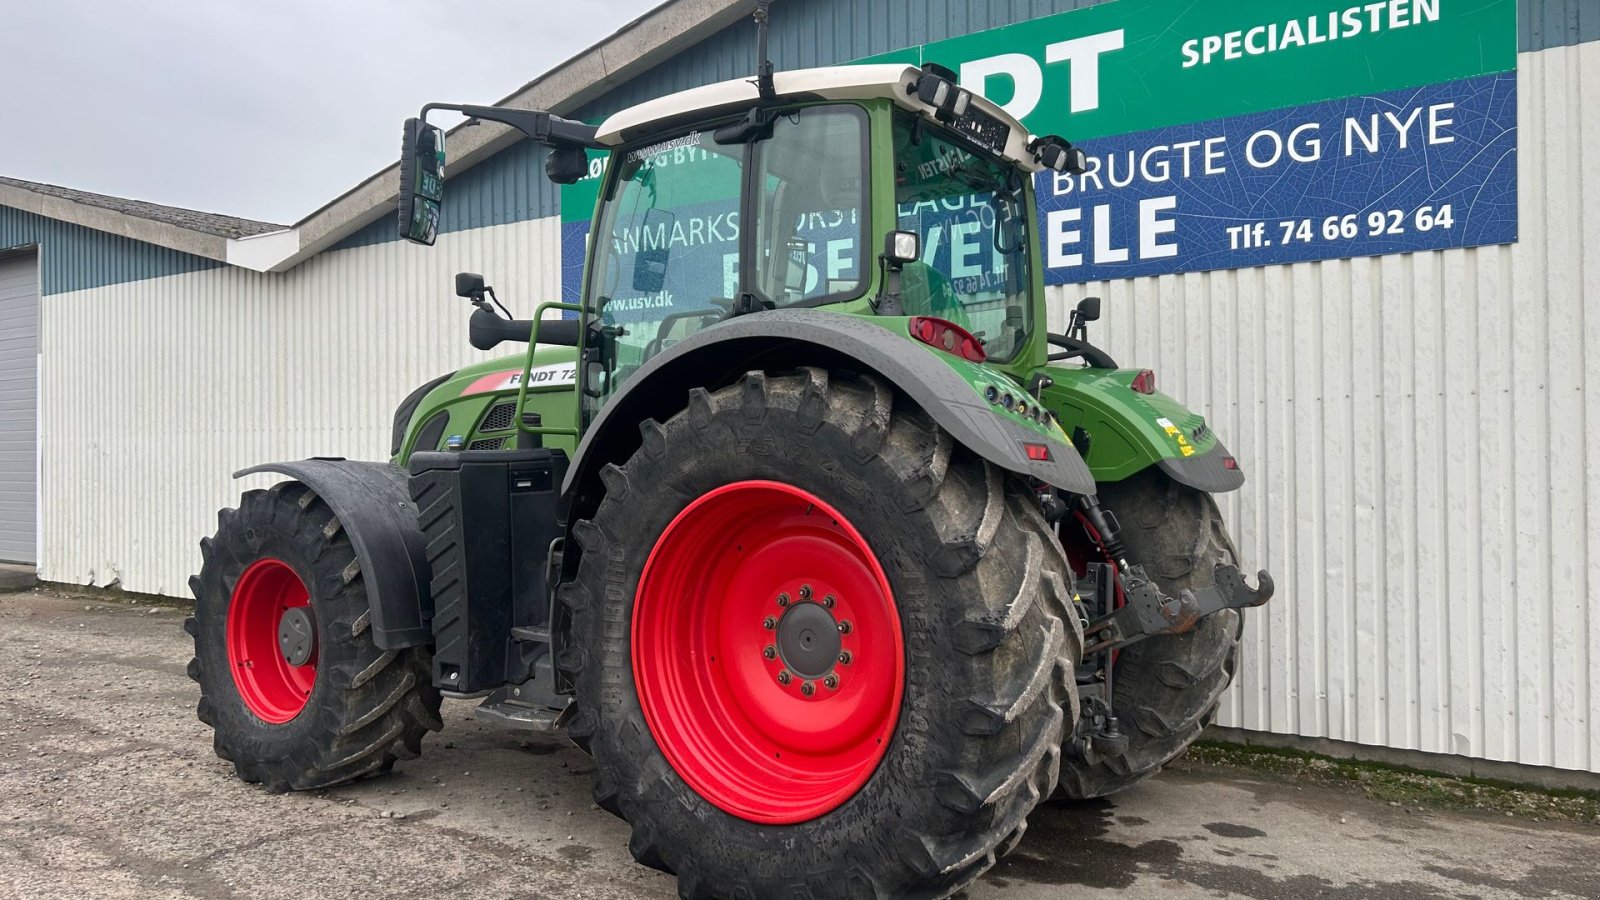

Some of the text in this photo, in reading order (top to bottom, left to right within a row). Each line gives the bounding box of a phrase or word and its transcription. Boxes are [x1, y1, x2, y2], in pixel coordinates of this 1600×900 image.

[1181, 0, 1440, 68] SPECIALISTEN
[627, 131, 700, 163] www.usv.dk
[1053, 136, 1227, 196] BRUGTE
[1245, 123, 1321, 168] OG
[1344, 102, 1455, 157] NYE
[1226, 204, 1454, 250] Tlf. 74 66 92 64
